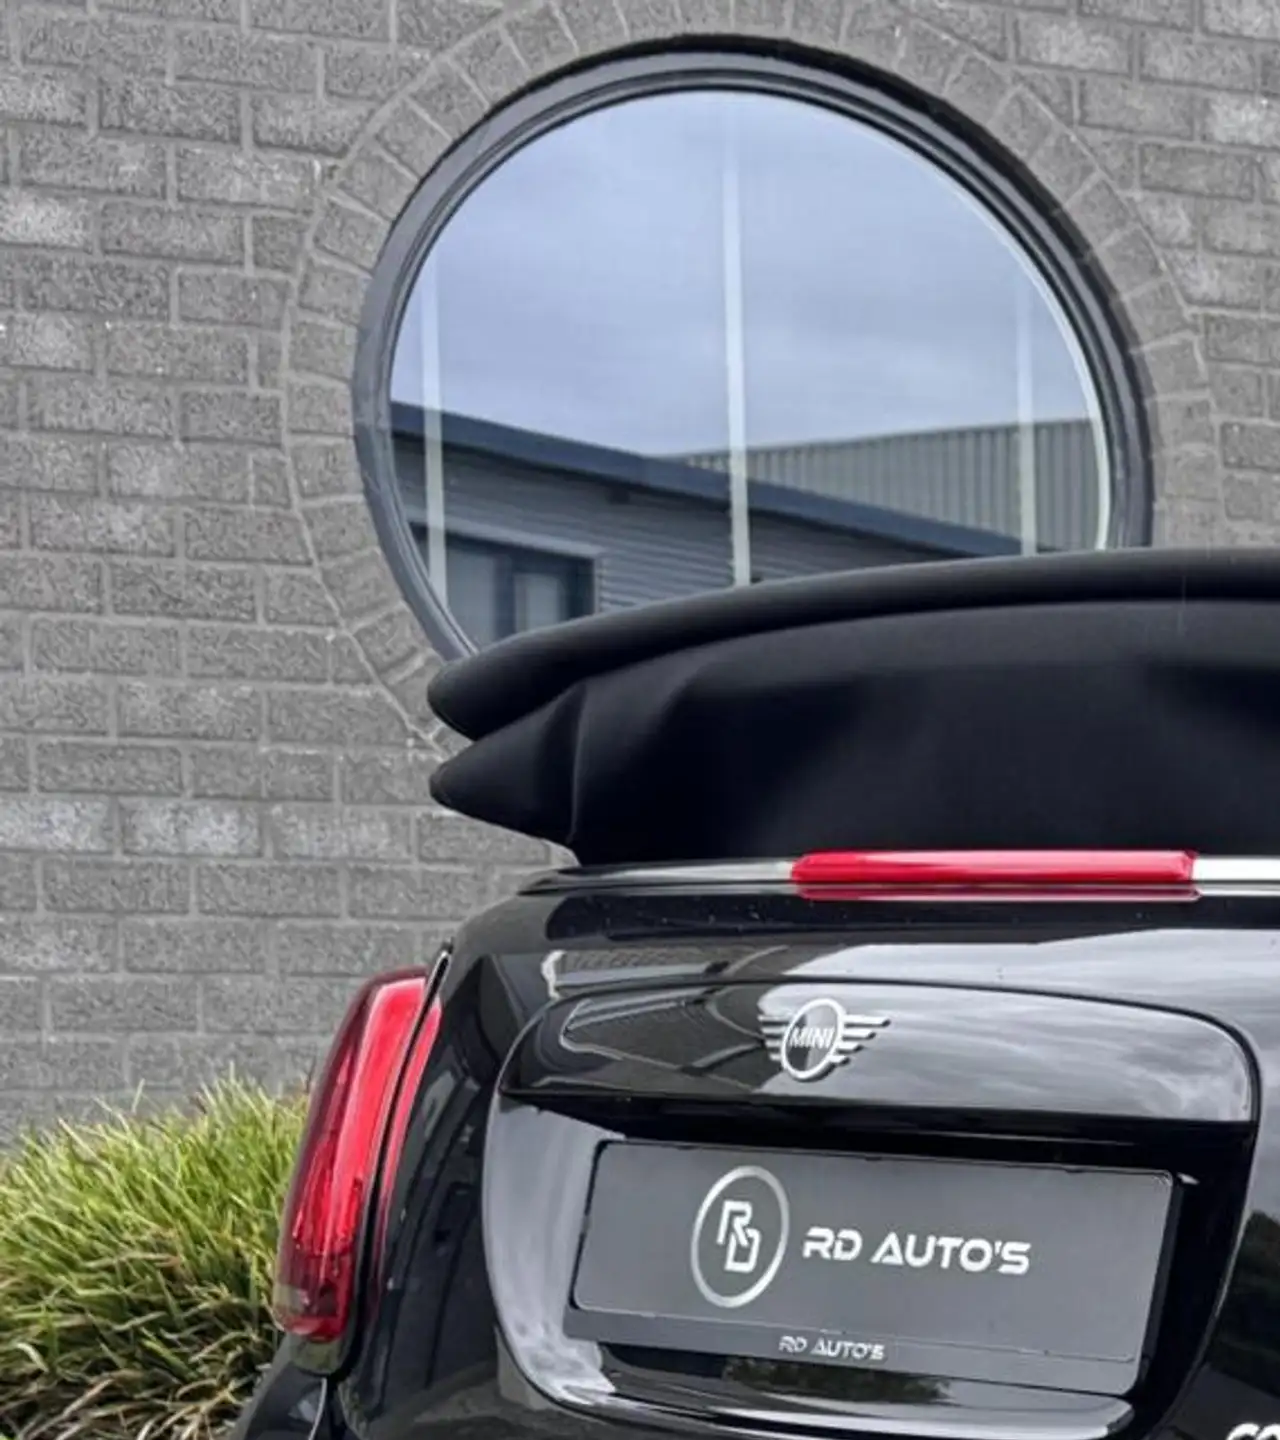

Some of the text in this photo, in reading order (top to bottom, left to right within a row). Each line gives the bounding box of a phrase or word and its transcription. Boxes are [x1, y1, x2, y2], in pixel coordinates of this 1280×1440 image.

[789, 1027, 836, 1049] MINI
[802, 1227, 1032, 1276] RD AUTO'S
[779, 1335, 885, 1361] RD AUTO'S
